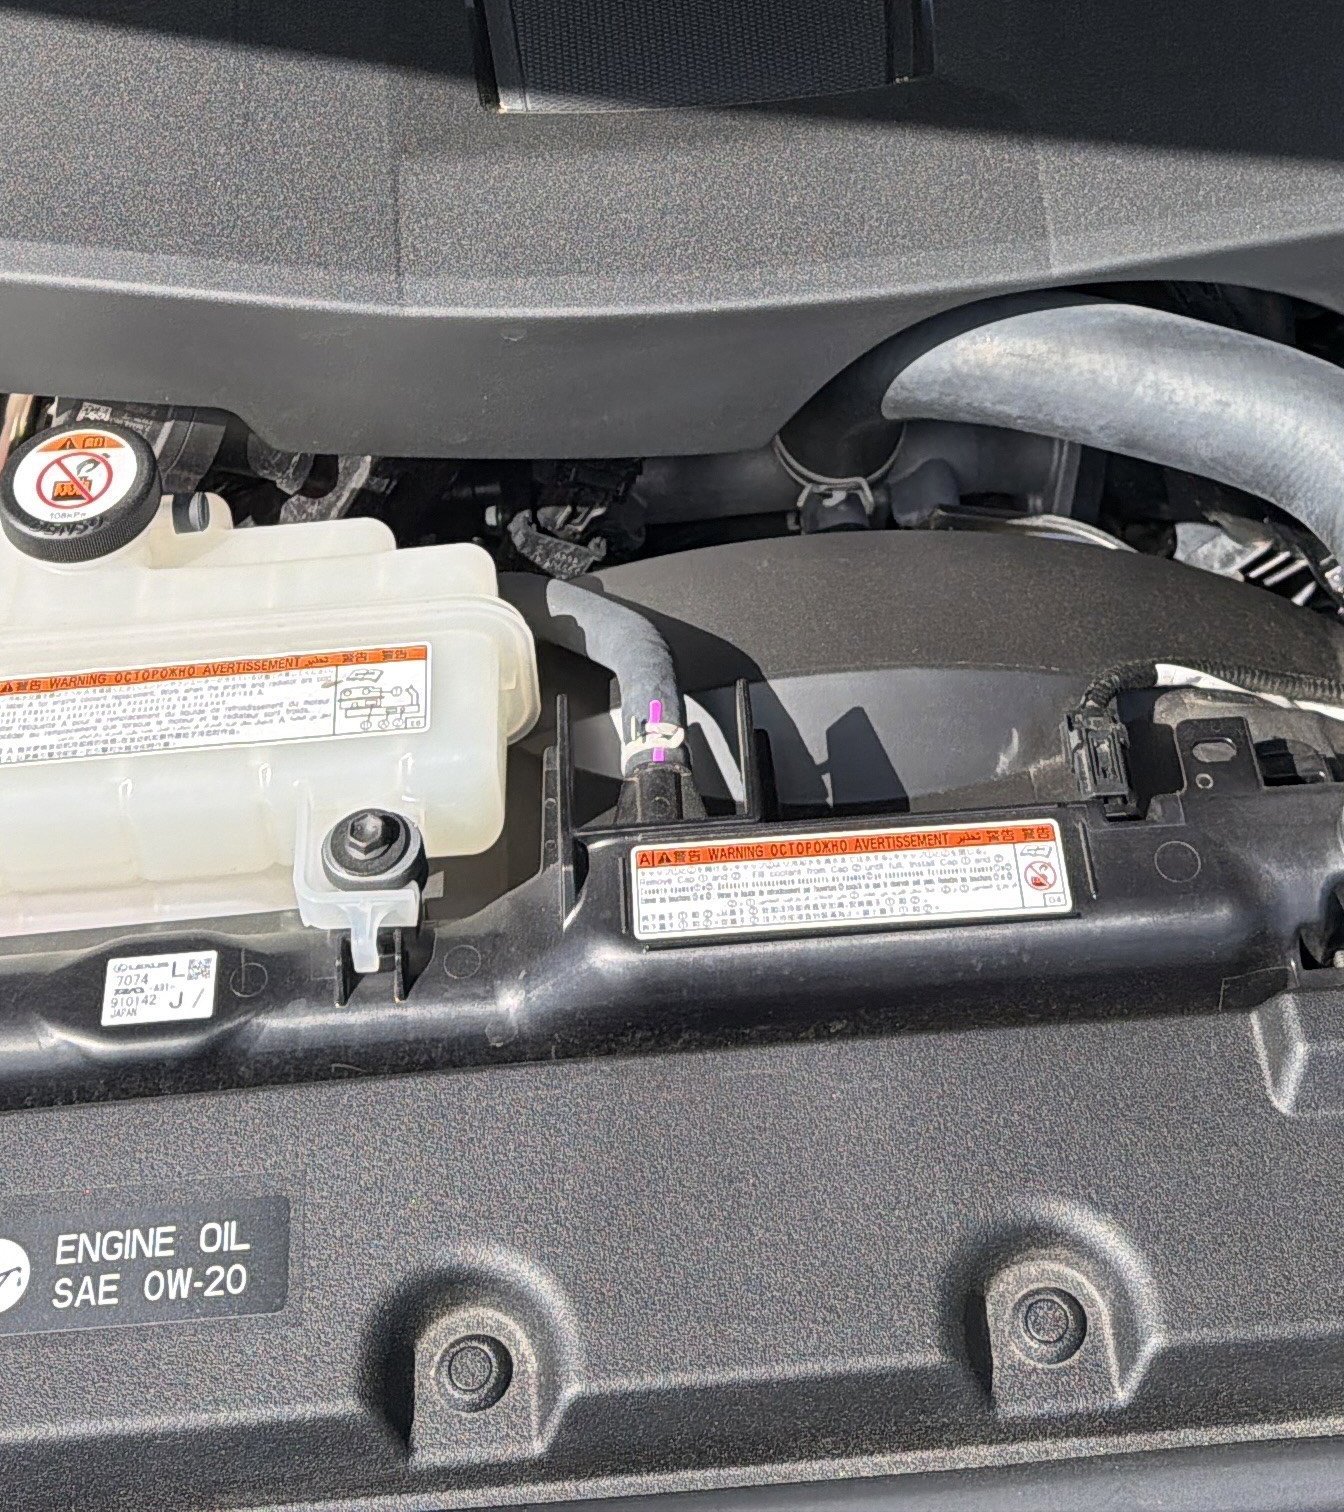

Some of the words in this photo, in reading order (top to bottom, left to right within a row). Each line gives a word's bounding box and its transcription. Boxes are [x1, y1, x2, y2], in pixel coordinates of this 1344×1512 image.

[49, 673, 107, 689] WARNING
[114, 665, 196, 683] ОСТОРОЖНО
[202, 658, 300, 676] AVERTISSEMENT
[708, 844, 764, 861] WARNING
[770, 839, 848, 857] ОСТОРОЖНО
[854, 831, 949, 851] AVERTISSEMENT
[117, 973, 149, 987] 7074
[171, 960, 185, 978] L
[168, 991, 183, 1009] J
[110, 1008, 137, 1019] JAPAN
[53, 1224, 177, 1266] ENGINE
[199, 1220, 251, 1253] OIL
[51, 1272, 120, 1310] SAE
[144, 1264, 248, 1302] 0W-20
